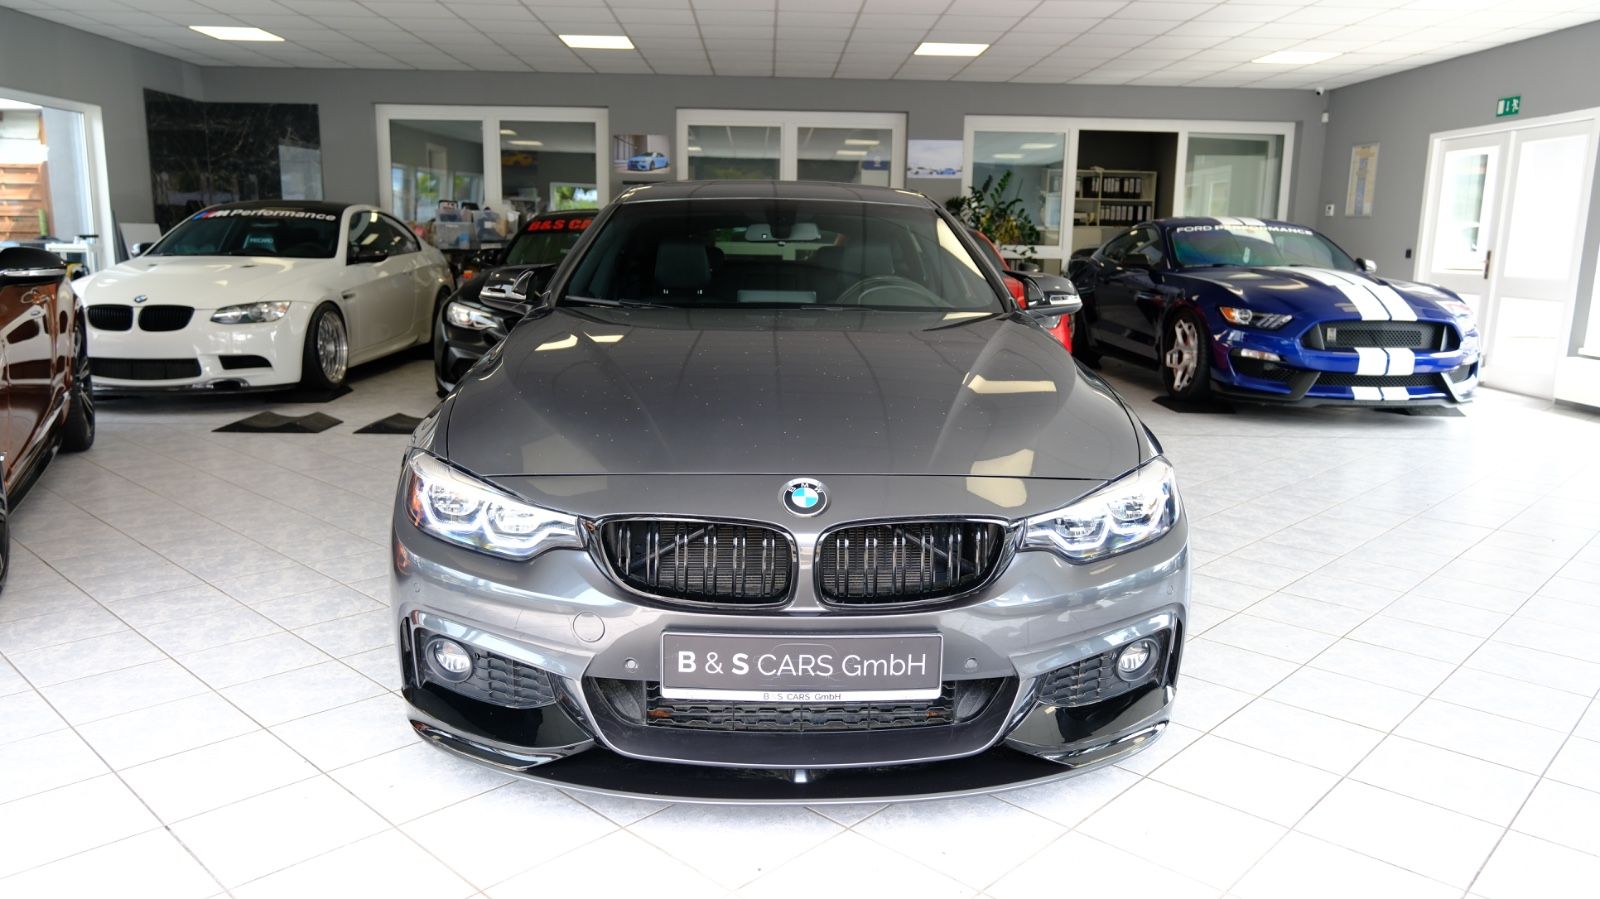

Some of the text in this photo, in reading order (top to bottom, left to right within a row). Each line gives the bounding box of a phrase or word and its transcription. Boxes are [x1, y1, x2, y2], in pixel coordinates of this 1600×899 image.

[230, 208, 336, 221] Performance
[1176, 225, 1213, 233] FORD
[678, 650, 926, 677] B & S CARS GmbH
[763, 692, 770, 700] B
[777, 692, 783, 700] S
[786, 692, 811, 701] CARS
[814, 692, 842, 701] GmbH
